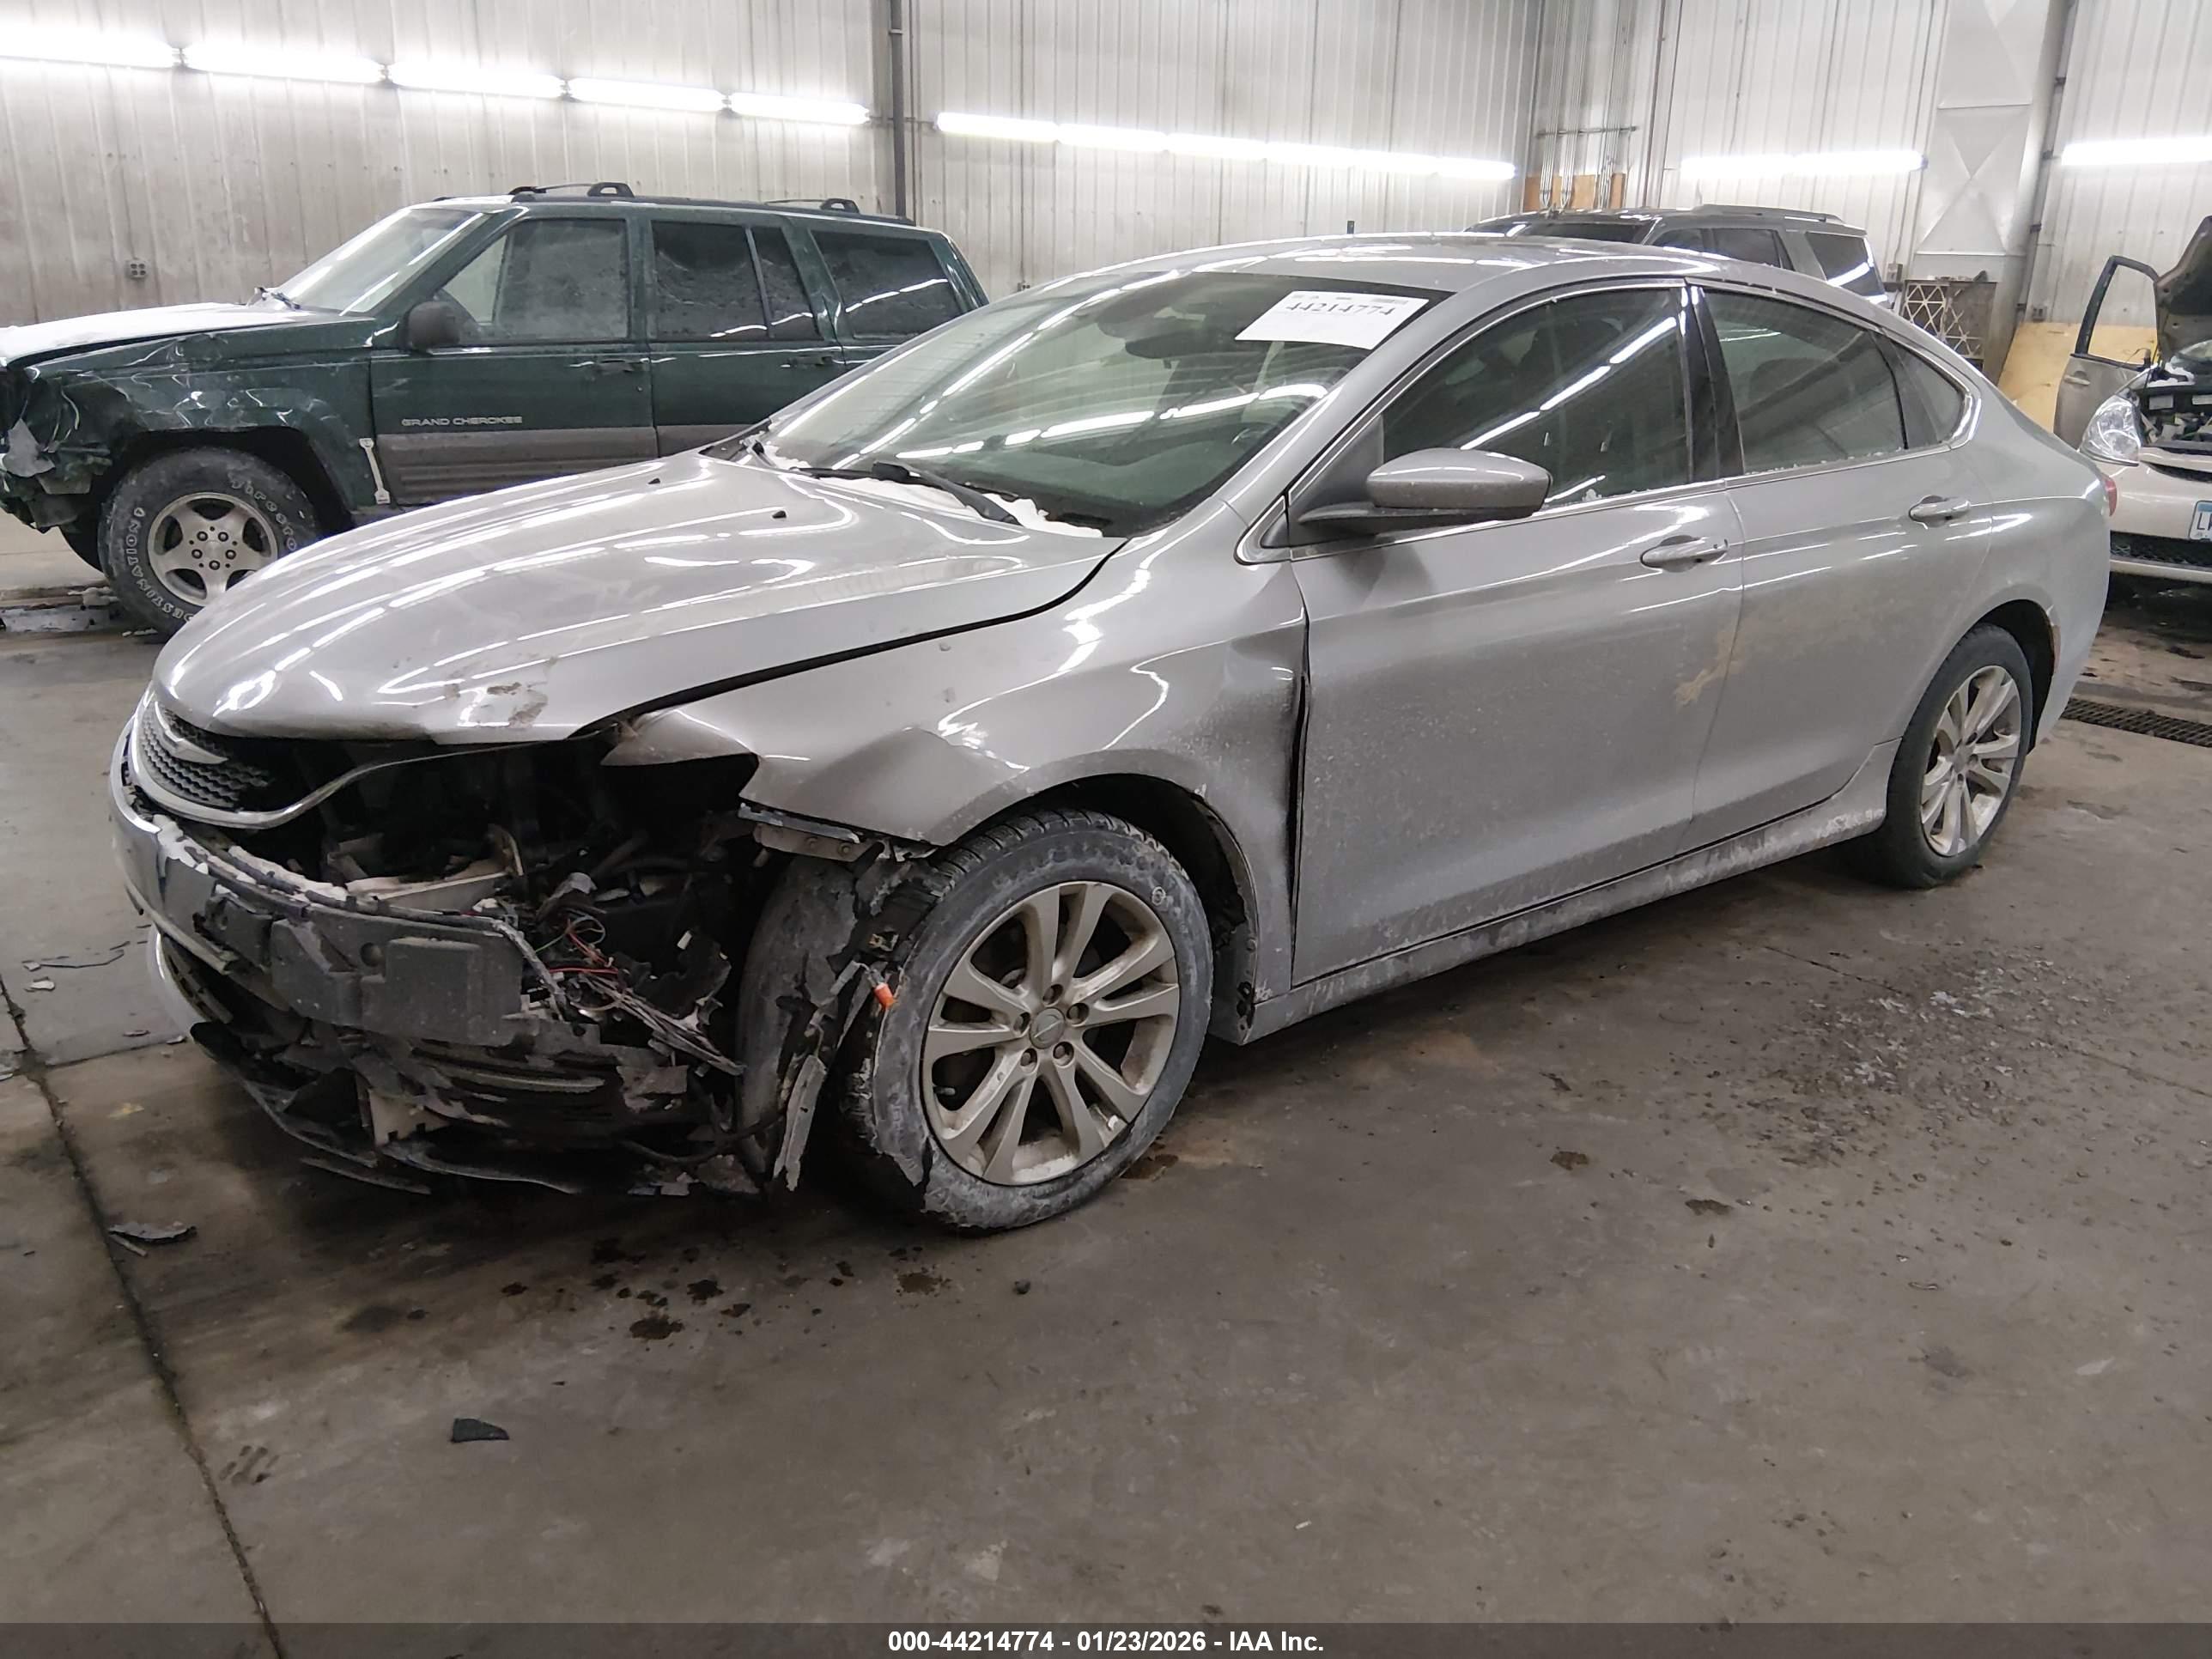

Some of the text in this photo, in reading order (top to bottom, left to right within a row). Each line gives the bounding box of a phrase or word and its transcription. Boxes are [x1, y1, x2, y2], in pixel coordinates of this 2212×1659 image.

[1286, 302, 1395, 315] 44214774
[401, 416, 523, 427] GRAND CHEROKEE
